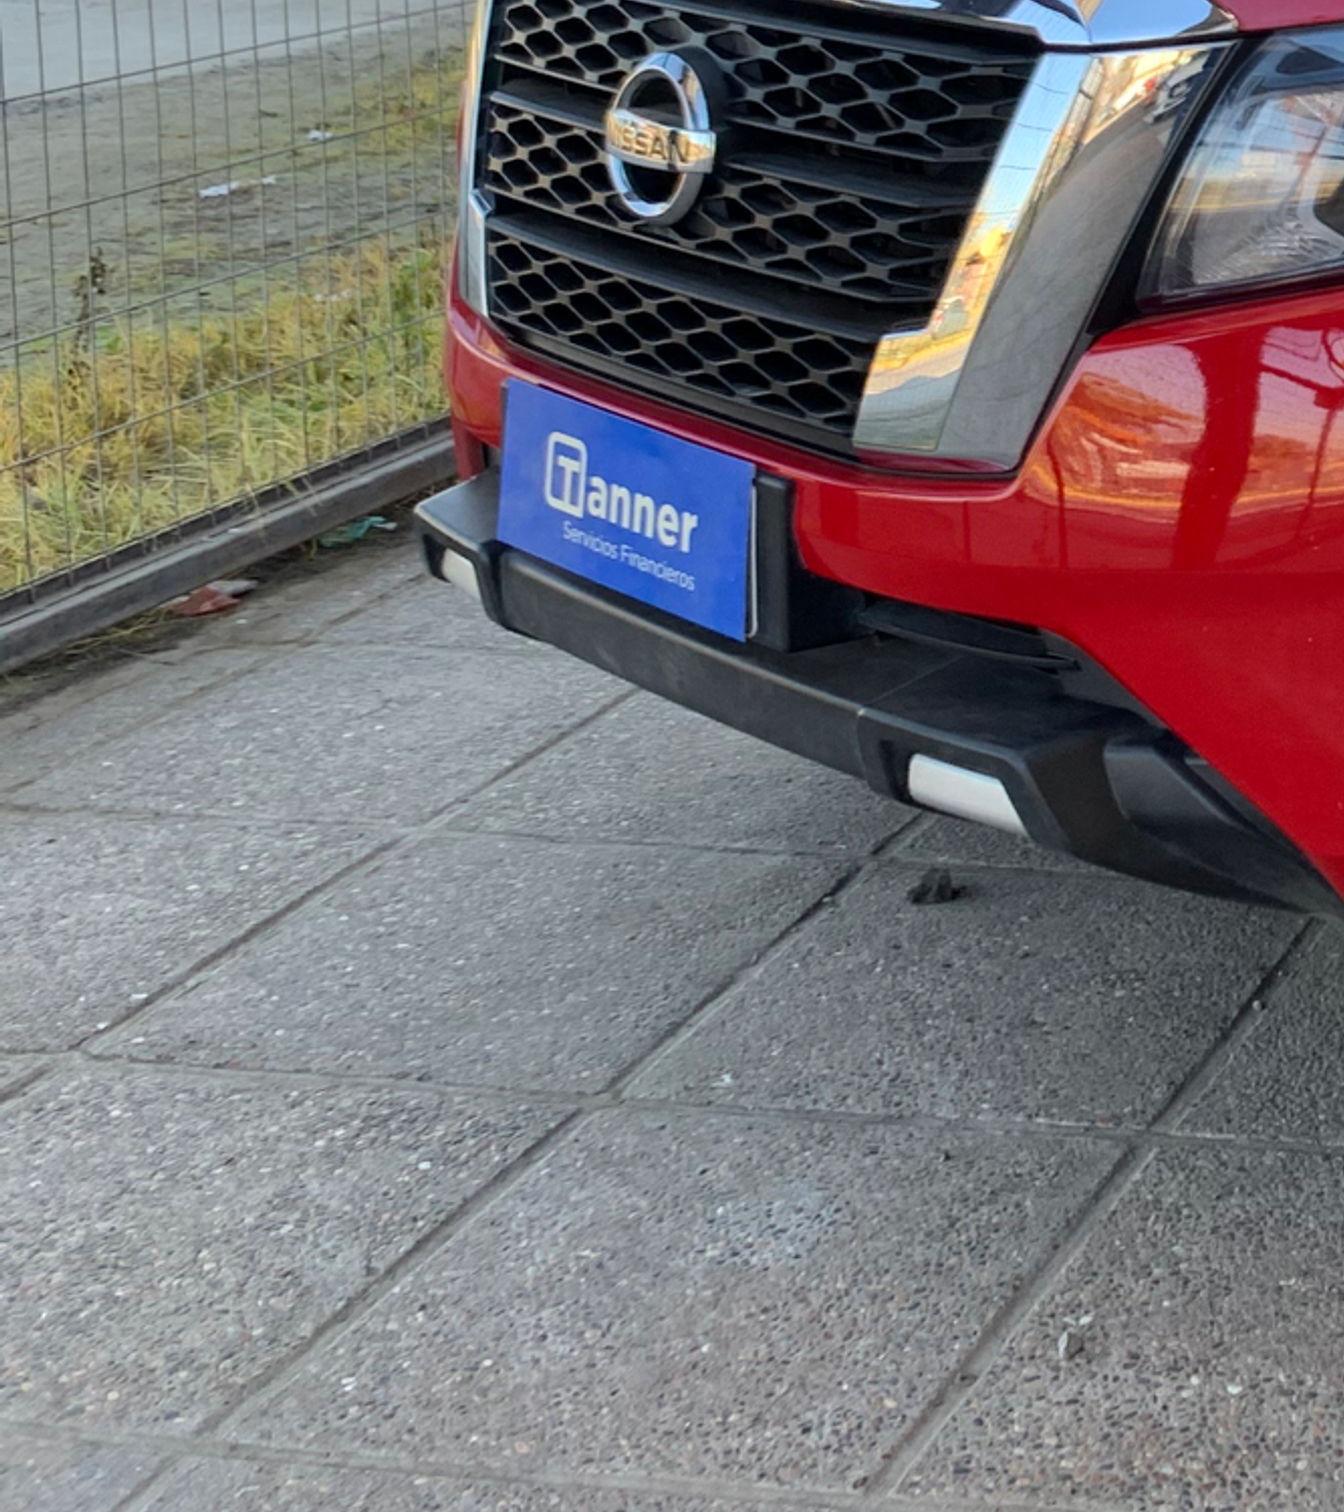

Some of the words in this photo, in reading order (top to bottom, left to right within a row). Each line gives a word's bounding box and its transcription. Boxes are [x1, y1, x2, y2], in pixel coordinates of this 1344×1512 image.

[544, 431, 699, 554] Tanner
[562, 520, 619, 560] Servicios
[620, 544, 696, 592] Financieros
